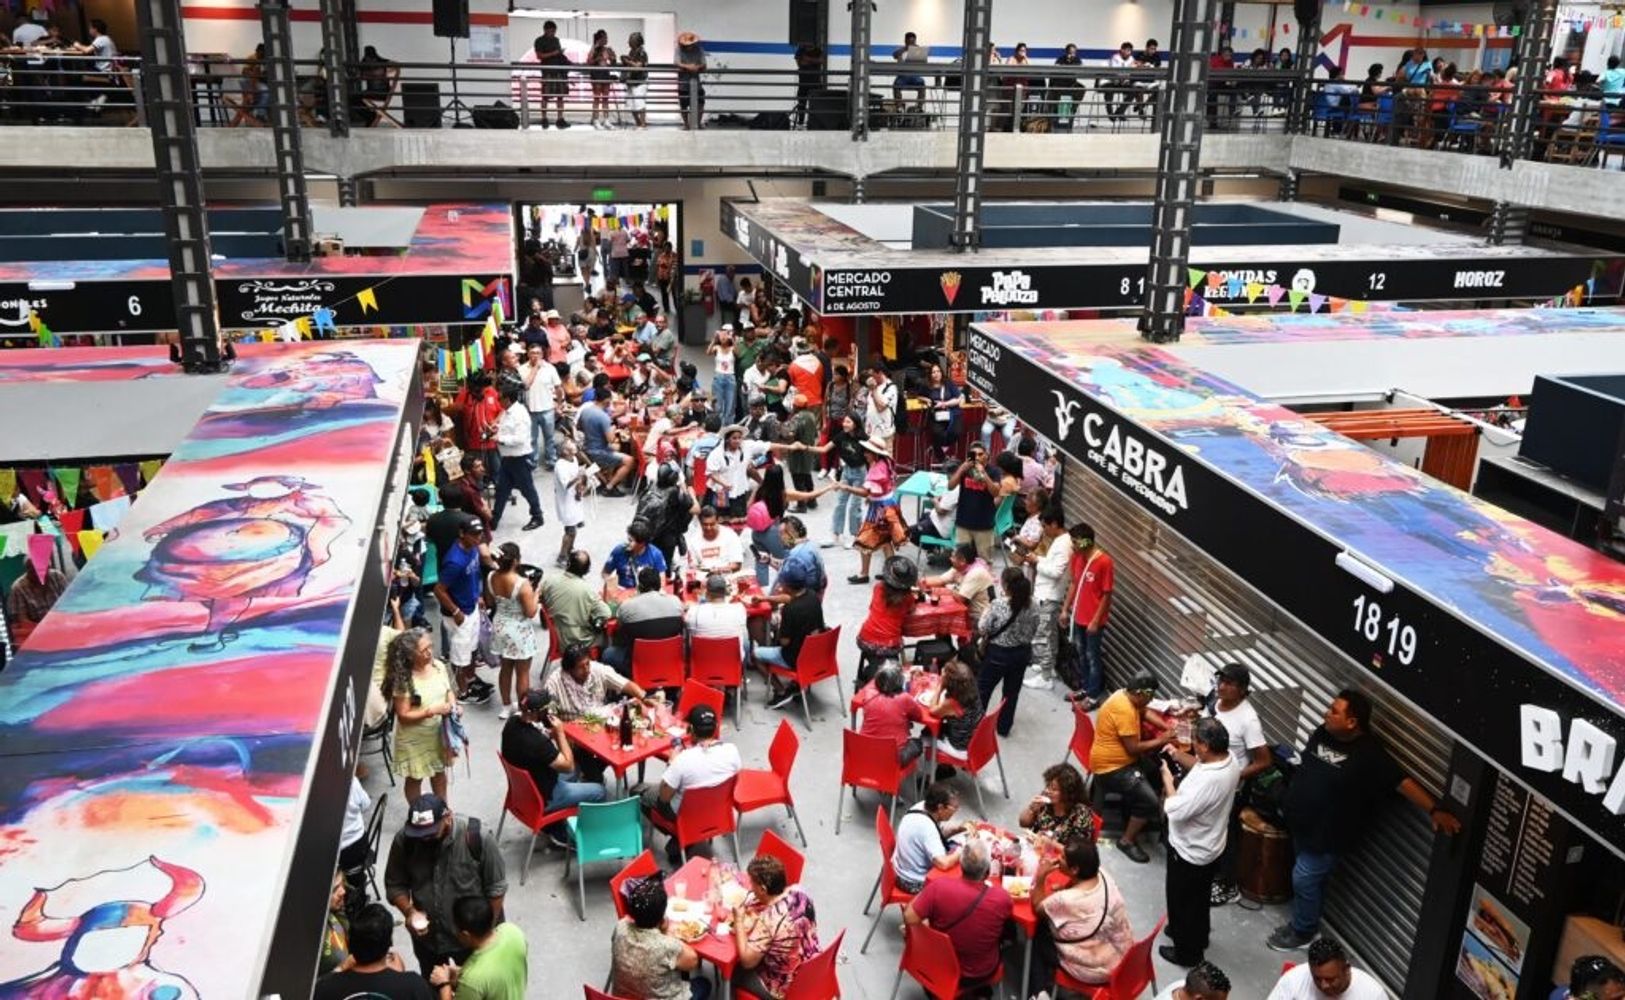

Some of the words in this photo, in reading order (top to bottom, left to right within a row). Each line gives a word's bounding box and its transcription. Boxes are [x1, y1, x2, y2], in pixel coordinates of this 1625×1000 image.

[826, 272, 892, 284] MERCADO
[1120, 277, 1130, 295] 8
[1368, 273, 1385, 290] 12
[1454, 270, 1505, 288] HOROZ
[826, 285, 885, 297] CENTRAL
[128, 296, 142, 315] 6
[833, 302, 844, 310] DE
[846, 301, 880, 310] AGOSTO
[1083, 412, 1188, 510] CABRA
[1353, 594, 1381, 641] 18
[1387, 617, 1417, 665] 19
